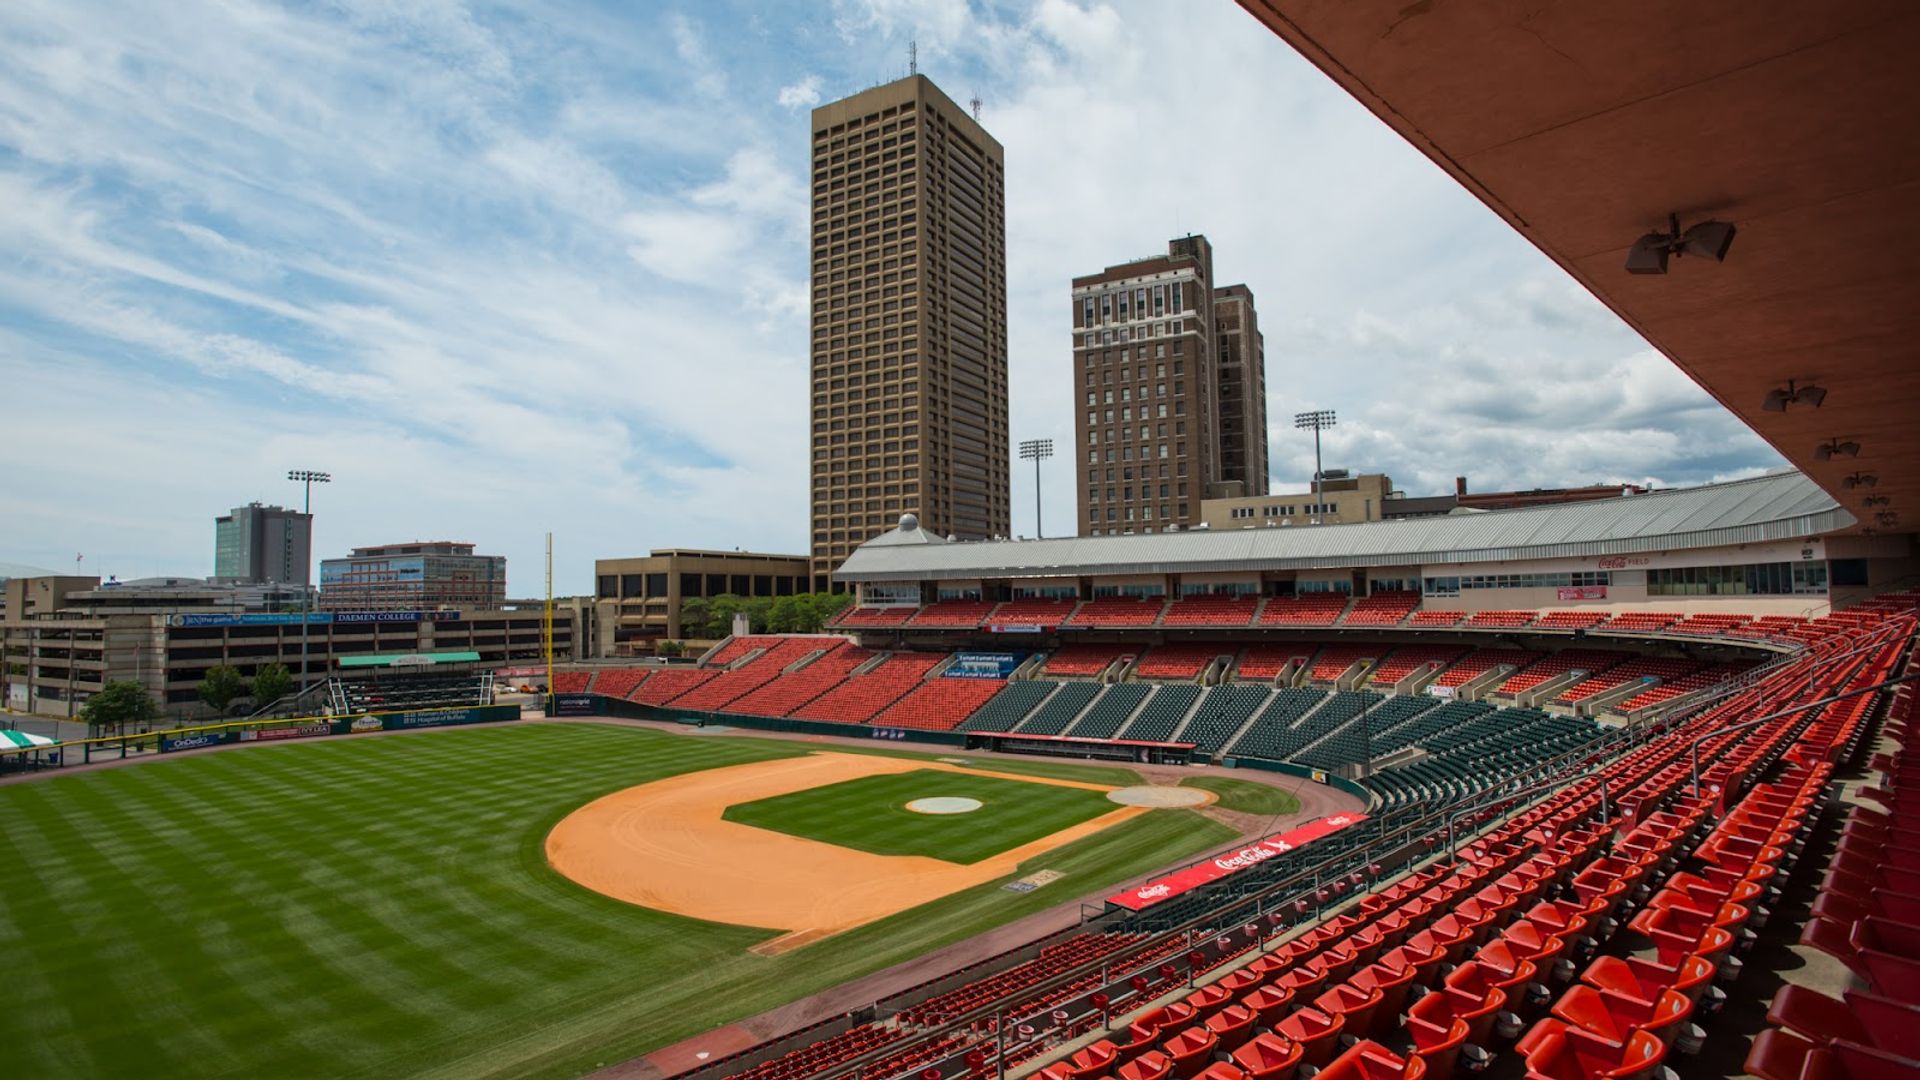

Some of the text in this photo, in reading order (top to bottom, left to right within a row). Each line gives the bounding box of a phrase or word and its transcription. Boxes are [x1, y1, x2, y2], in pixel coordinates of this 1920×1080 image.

[1628, 557, 1649, 566] FIELD
[338, 613, 376, 622] DAEMEN
[377, 612, 416, 621] COLLEGE
